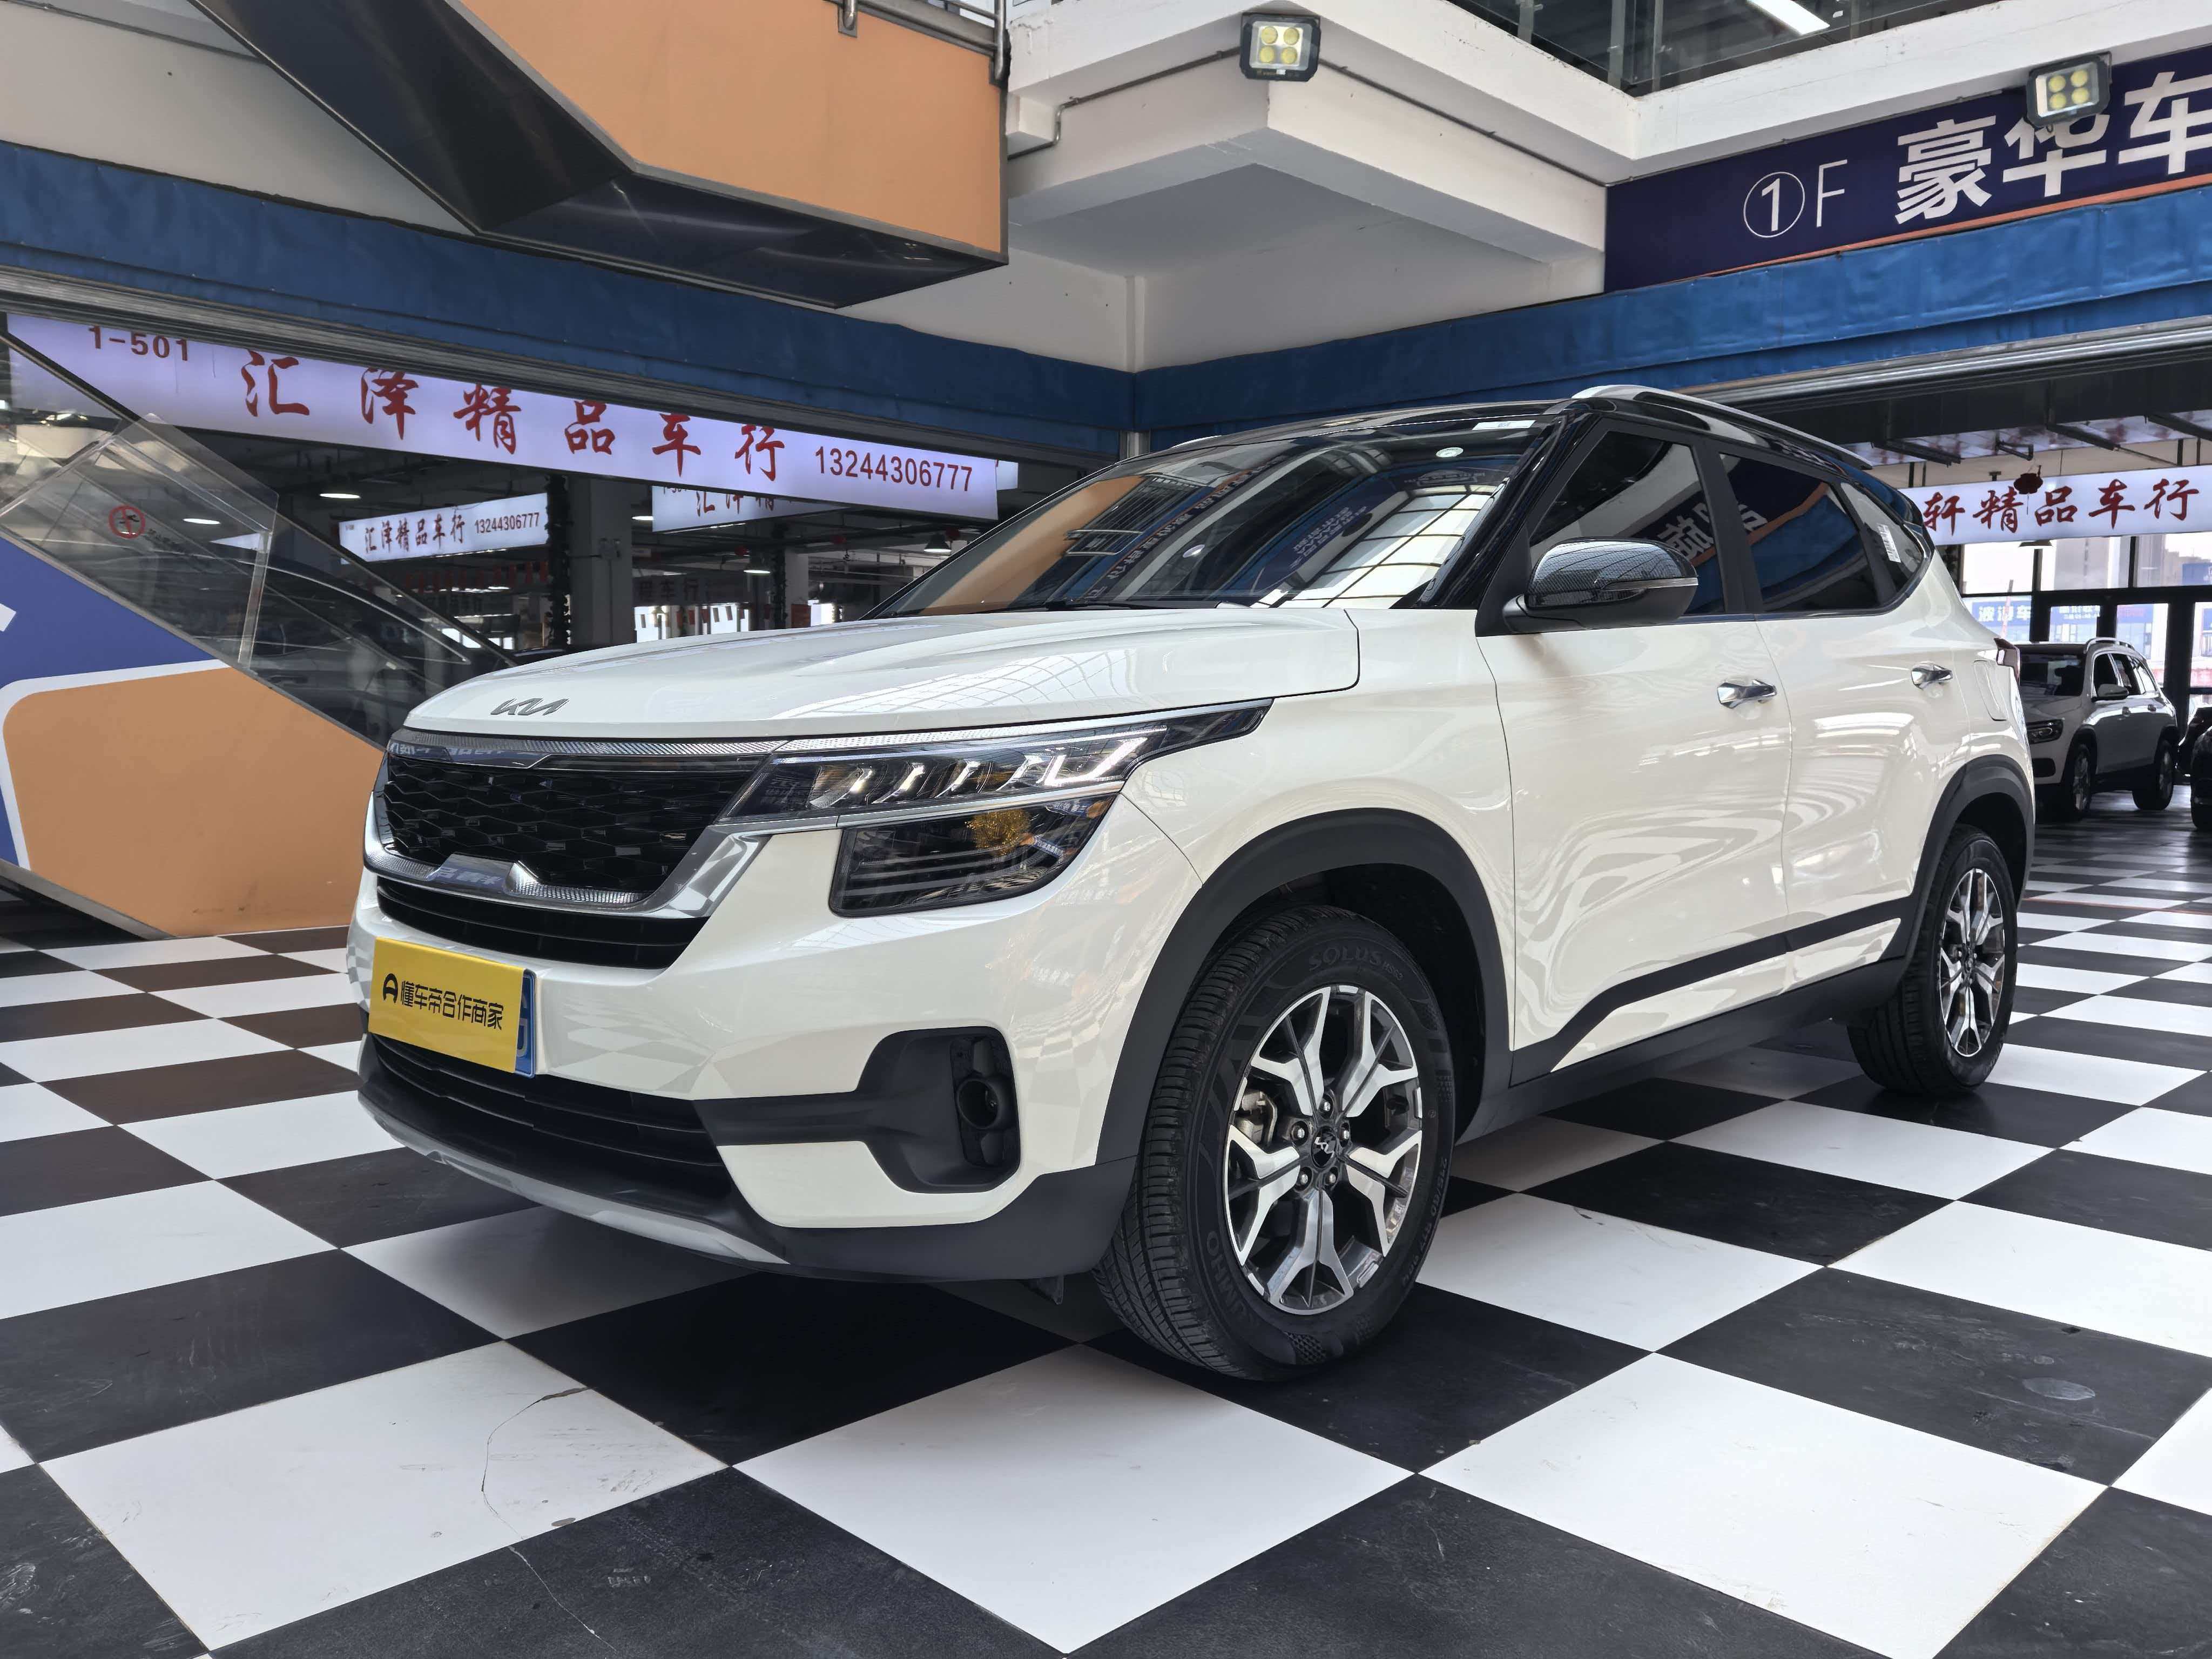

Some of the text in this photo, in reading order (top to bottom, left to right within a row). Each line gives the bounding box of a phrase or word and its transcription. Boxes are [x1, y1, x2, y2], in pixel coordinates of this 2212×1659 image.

[89, 325, 973, 492] 1-501 汇泽精品车行 13244306777
[365, 512, 540, 554] 汇泽精品车行 13244306777
[490, 697, 570, 716] KIA
[1309, 946, 1382, 972] SOLUS
[400, 980, 504, 1030] 懂车帝合作商家
